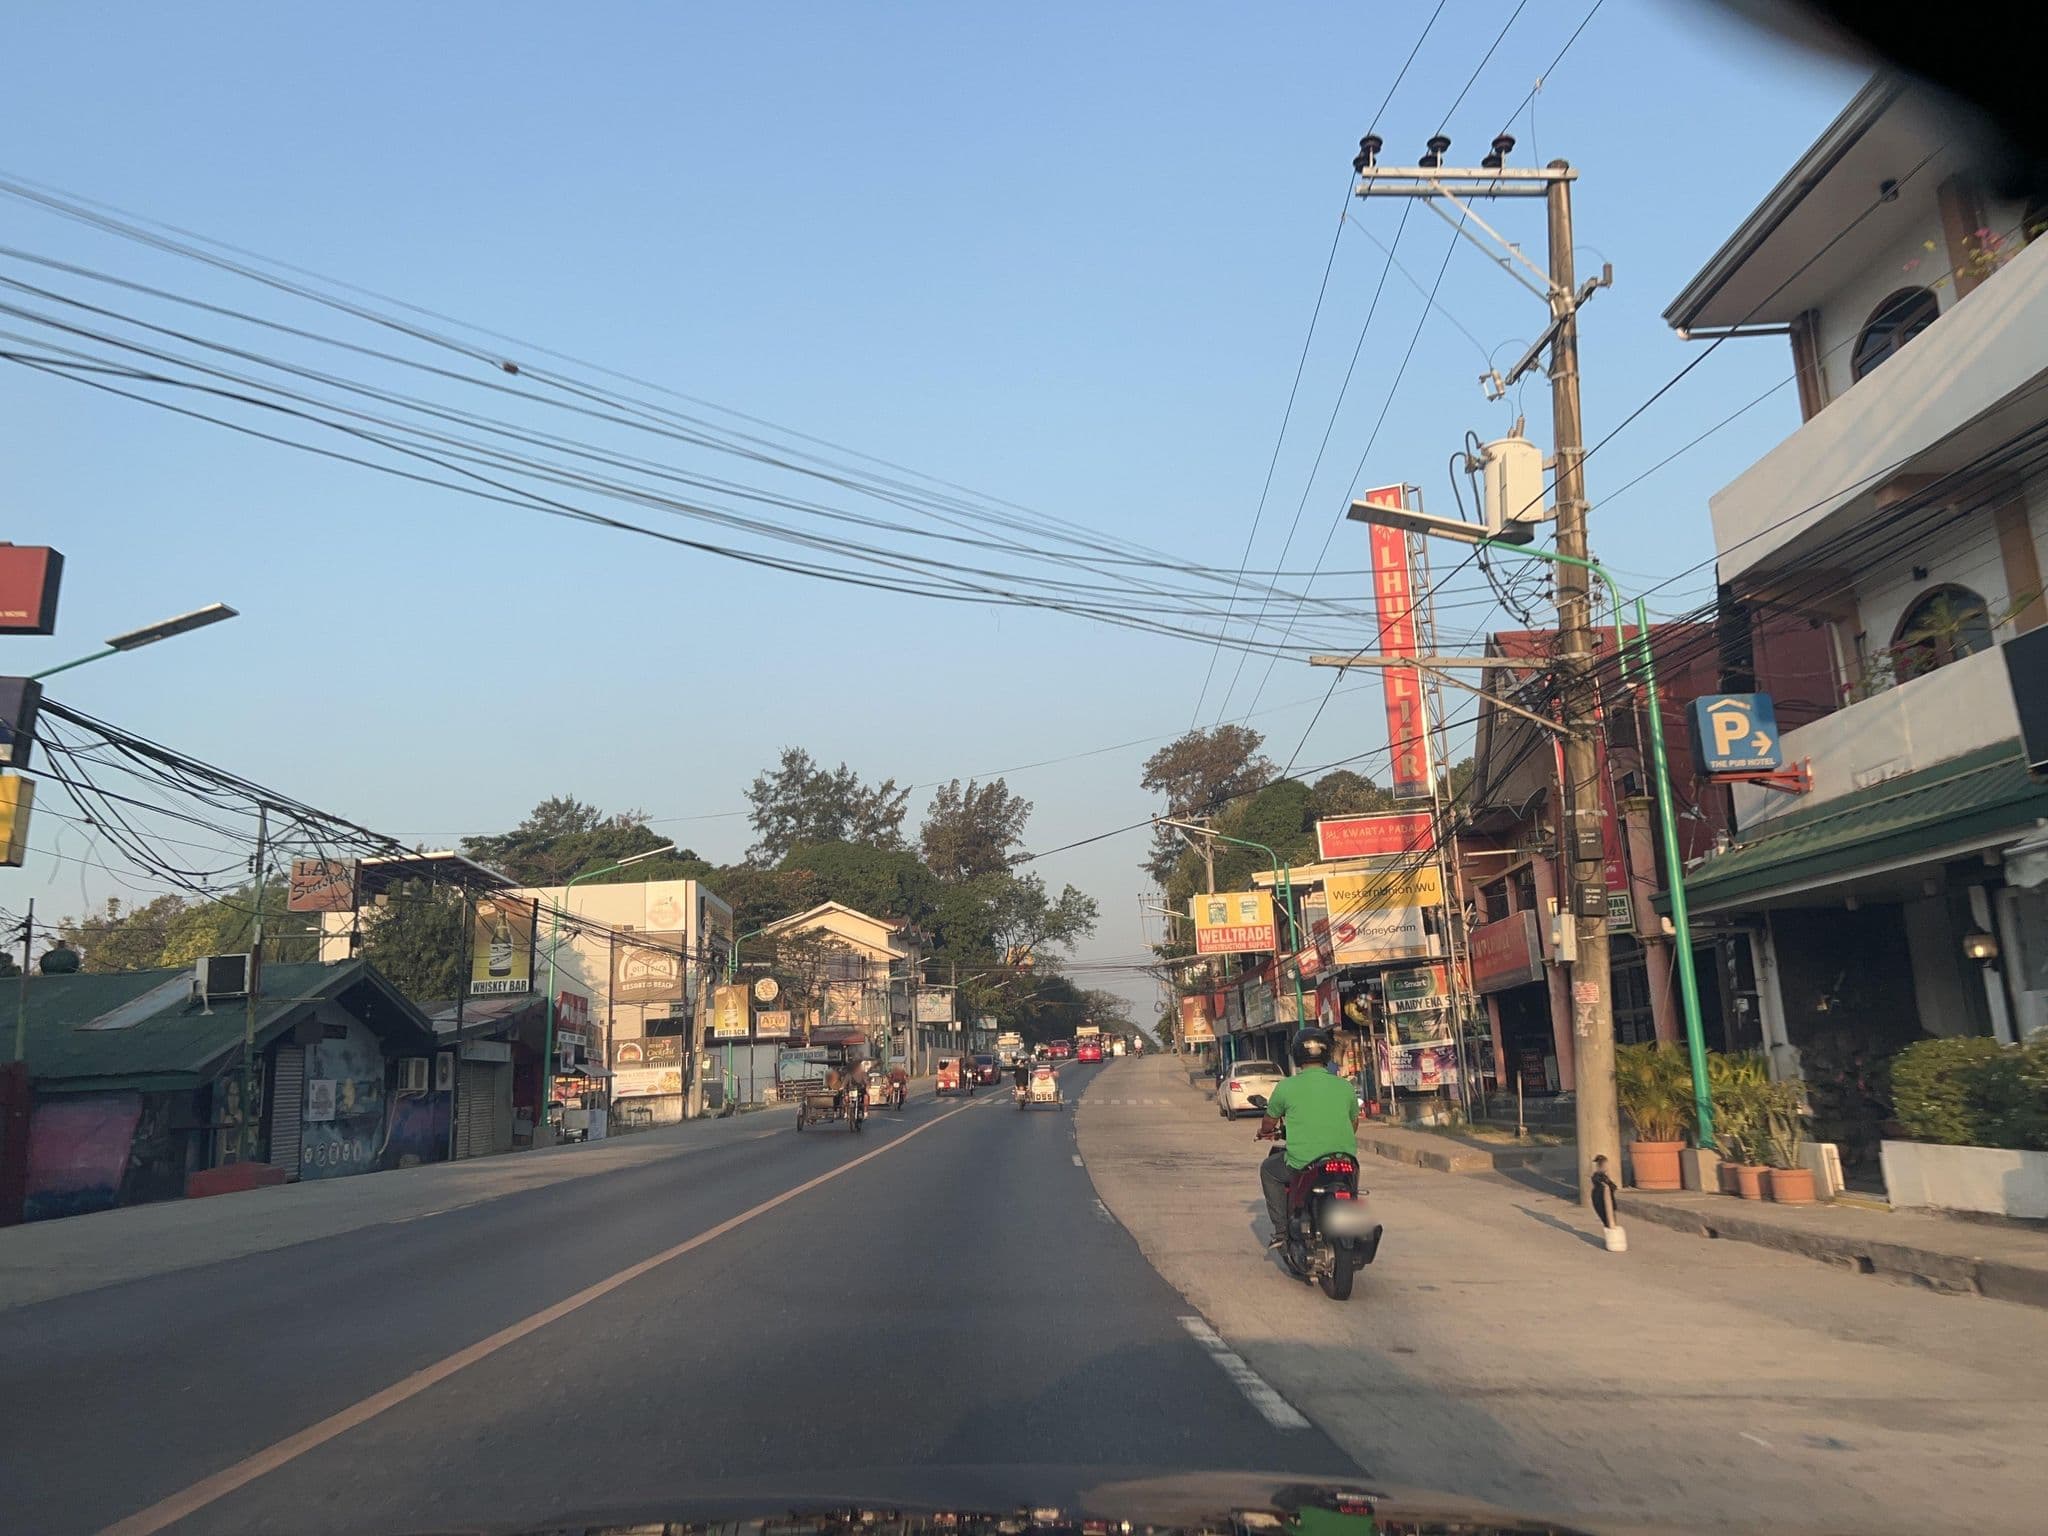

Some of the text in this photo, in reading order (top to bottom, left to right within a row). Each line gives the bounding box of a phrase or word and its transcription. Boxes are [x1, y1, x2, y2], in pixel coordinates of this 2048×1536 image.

[1712, 712, 1750, 756] P
[1711, 758, 1776, 768] THE PUB HOTEL
[1343, 826, 1385, 838] KWARTA
[1388, 824, 1426, 833] PADALA
[1416, 882, 1436, 892] WU
[1608, 908, 1628, 917] ESS
[1357, 924, 1416, 936] MoneyGram
[1199, 927, 1272, 944] WELLTRADE
[1202, 941, 1271, 951] CONSTRUCTION SUPPLY
[473, 980, 527, 993] WHISKEY BAR
[623, 982, 646, 990] RESORT
[1404, 979, 1427, 988] Smart
[762, 1015, 785, 1025] ATM
